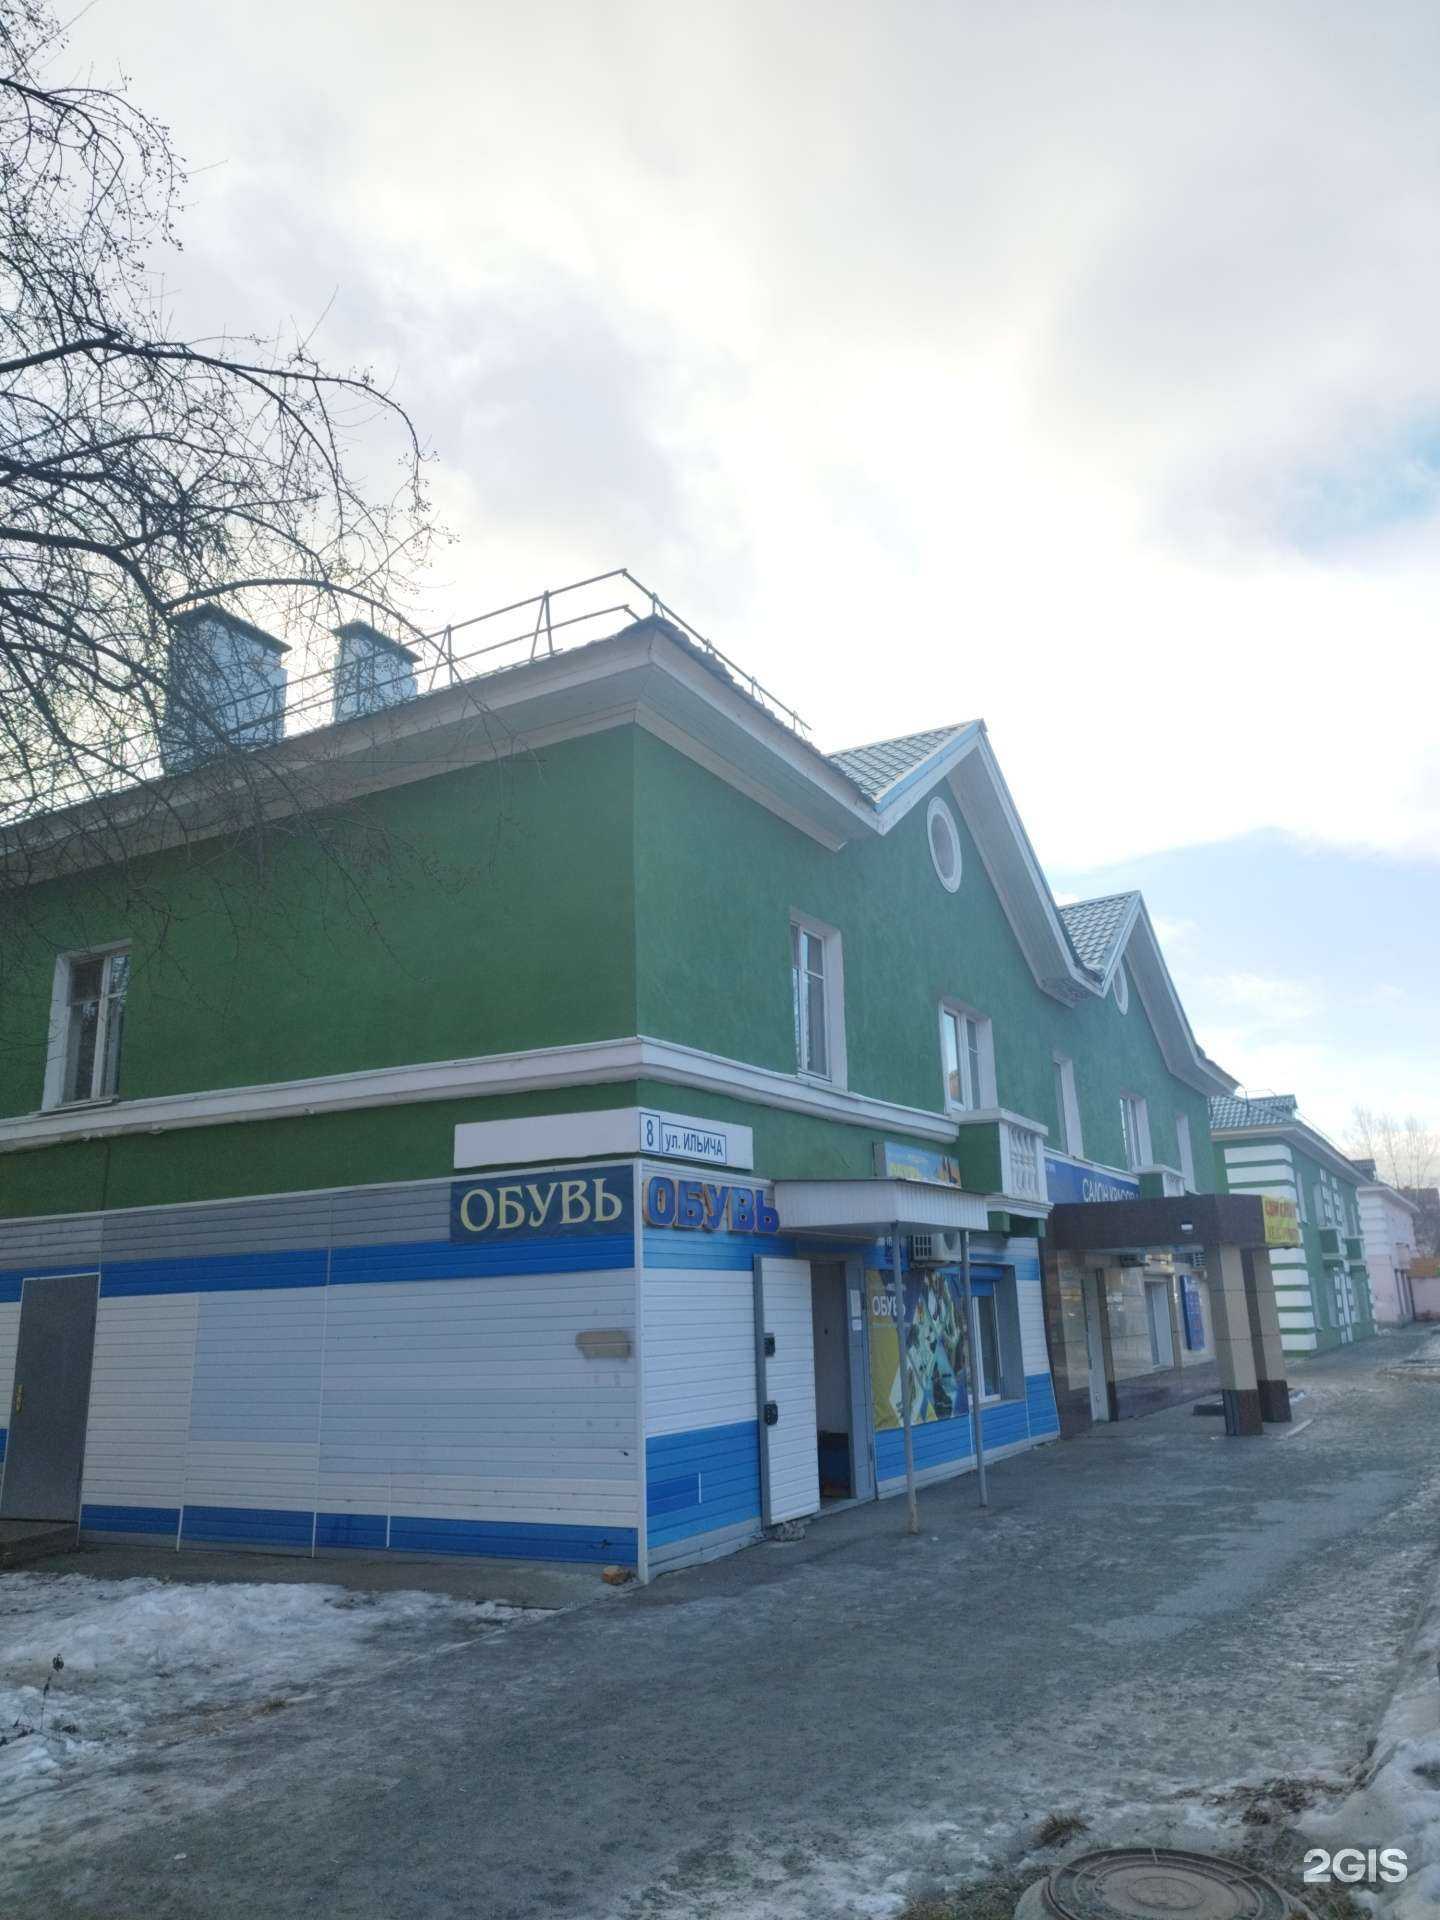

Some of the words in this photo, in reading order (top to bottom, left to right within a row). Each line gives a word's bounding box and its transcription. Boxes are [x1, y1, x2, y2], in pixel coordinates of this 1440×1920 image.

[646, 1119, 654, 1147] 8
[665, 1133, 681, 1151] ул.
[683, 1133, 723, 1156] ИЛЬИЧА
[459, 1177, 623, 1232] ОБУВЬ
[642, 1175, 781, 1232] ОБУВЬ
